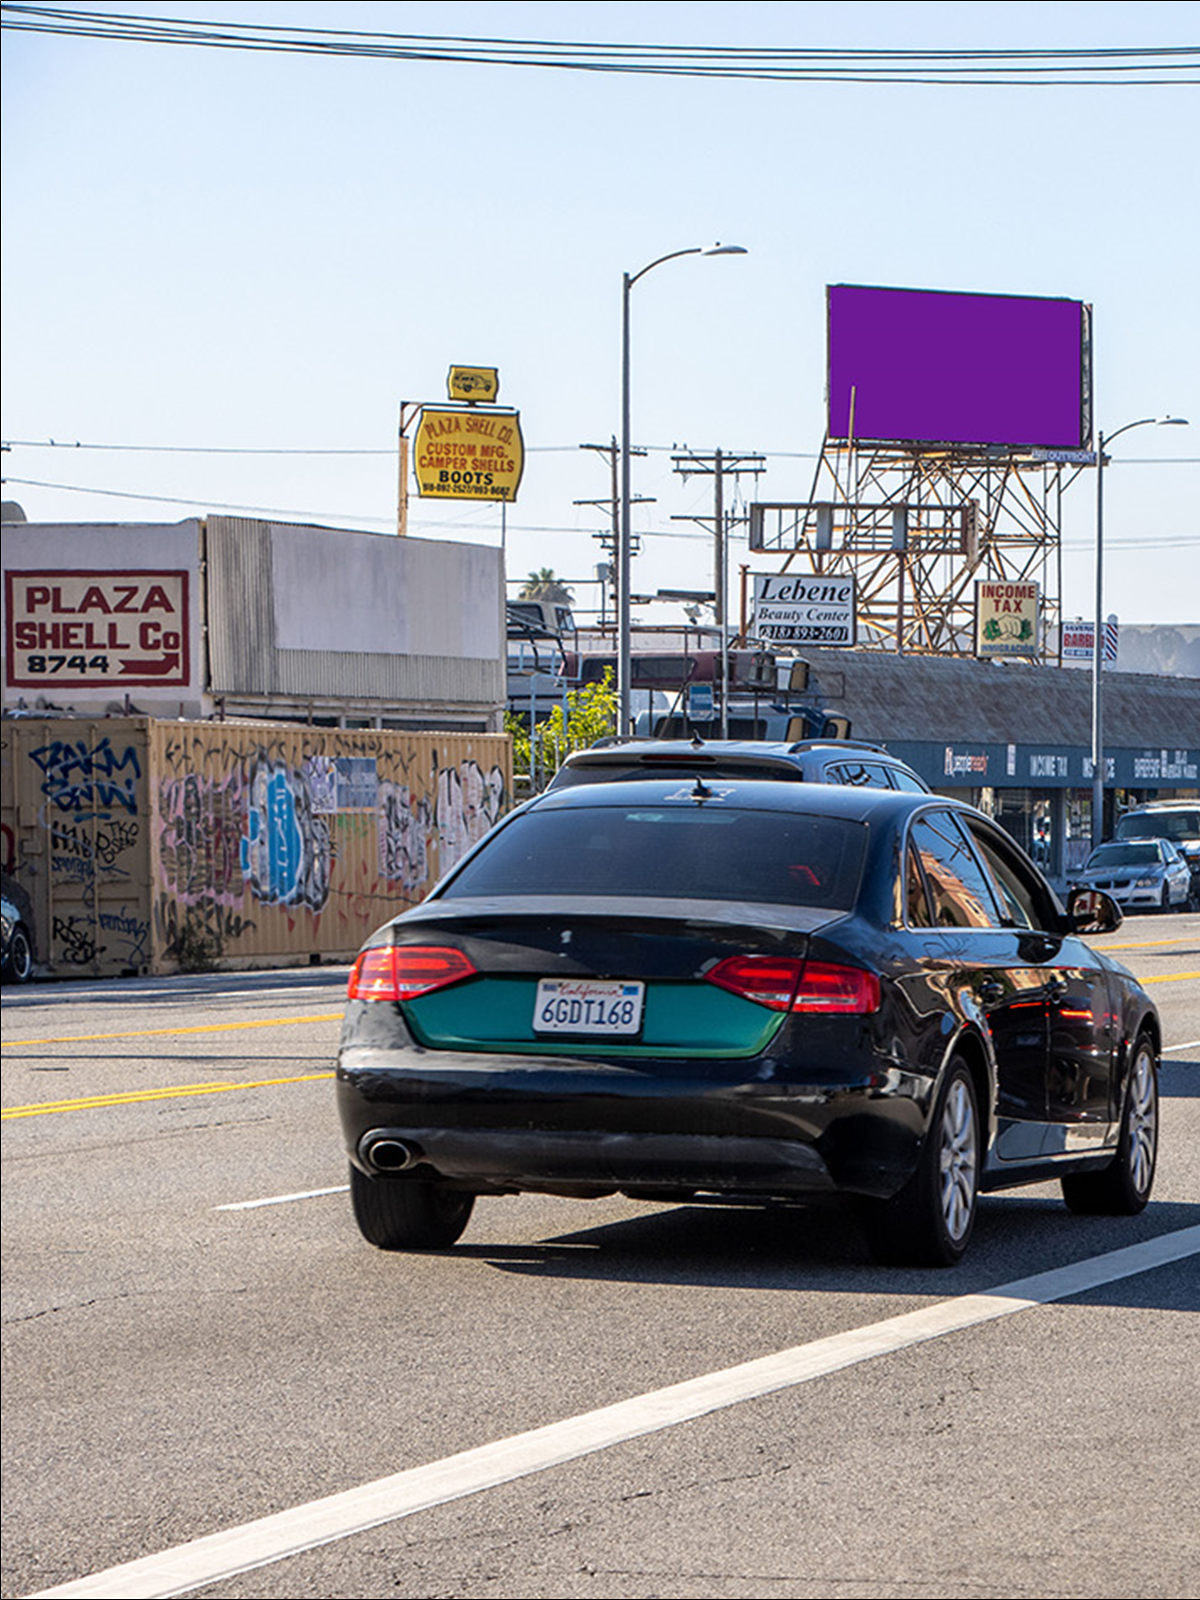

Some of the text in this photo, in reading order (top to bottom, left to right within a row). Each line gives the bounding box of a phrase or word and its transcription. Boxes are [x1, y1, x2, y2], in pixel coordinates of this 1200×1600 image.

[423, 417, 514, 446] PLAZA SHELL CO.
[426, 442, 509, 459] CUSTOM MFG.
[419, 455, 515, 473] CAMPER SHELLS
[439, 470, 494, 486] BOOTS
[760, 578, 851, 602] Lebene
[981, 585, 1036, 599] INCOME
[26, 586, 175, 614] PLAZA
[993, 599, 1023, 613] TAX
[758, 607, 850, 623] Beauty Center
[15, 622, 180, 651] SHELL Co
[759, 626, 848, 640] (818) 893-2601
[27, 655, 109, 674] 8744
[558, 983, 622, 999] California
[541, 998, 634, 1025] 6GDT168
